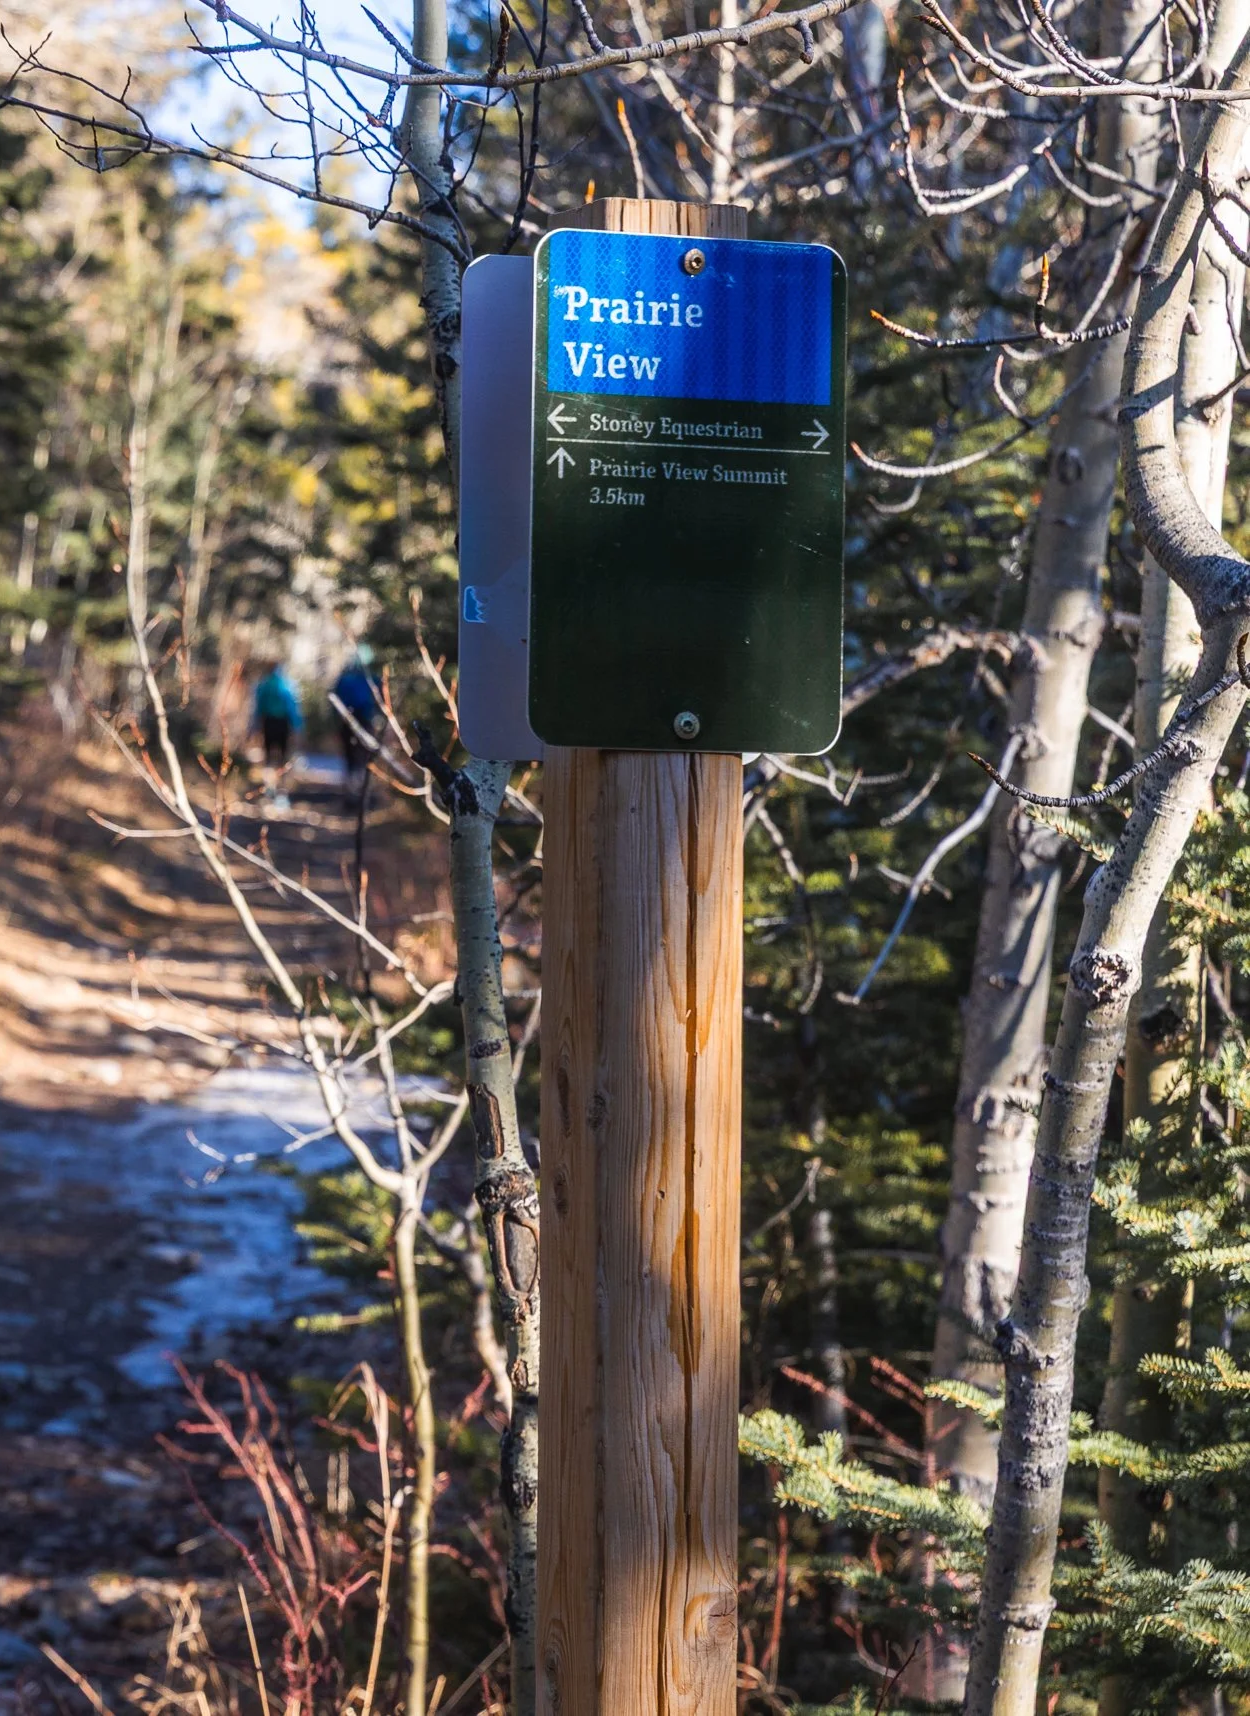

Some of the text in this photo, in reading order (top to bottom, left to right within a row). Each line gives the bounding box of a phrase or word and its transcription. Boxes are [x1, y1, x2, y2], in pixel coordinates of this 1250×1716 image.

[563, 285, 703, 328] Prairie
[563, 341, 662, 381] View
[589, 413, 763, 440] Stoney Equestrian
[589, 458, 788, 485] Prairie View Summit
[589, 487, 645, 505] 3.5km
